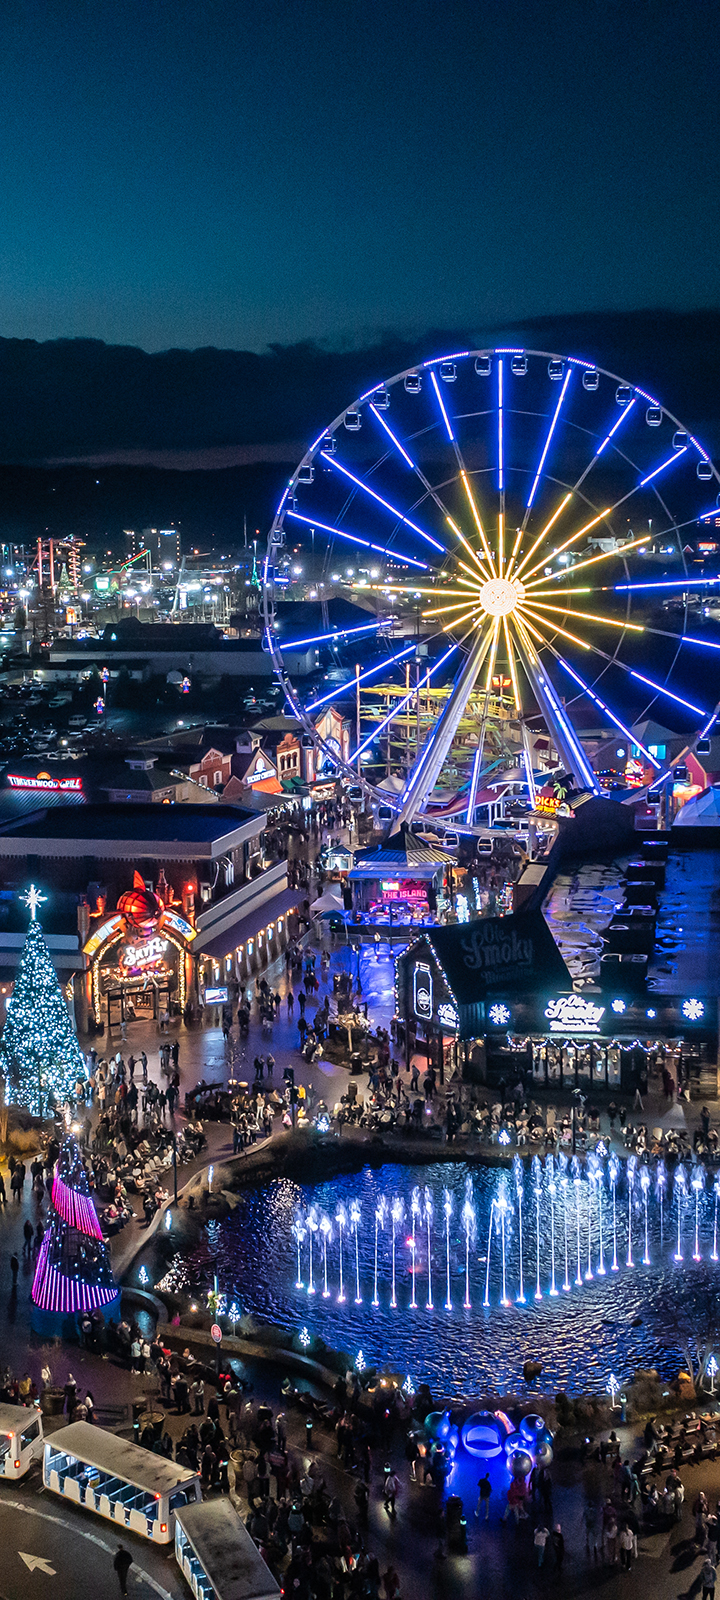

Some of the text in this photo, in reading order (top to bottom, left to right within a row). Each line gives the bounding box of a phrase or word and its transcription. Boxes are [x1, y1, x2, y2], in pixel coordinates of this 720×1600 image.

[7, 776, 81, 789] TIMBERWOOD GRILL
[535, 796, 560, 808] DICK'S
[382, 890, 427, 899] THE ISLAND
[483, 922, 511, 943] Ole
[460, 930, 533, 969] Smoky
